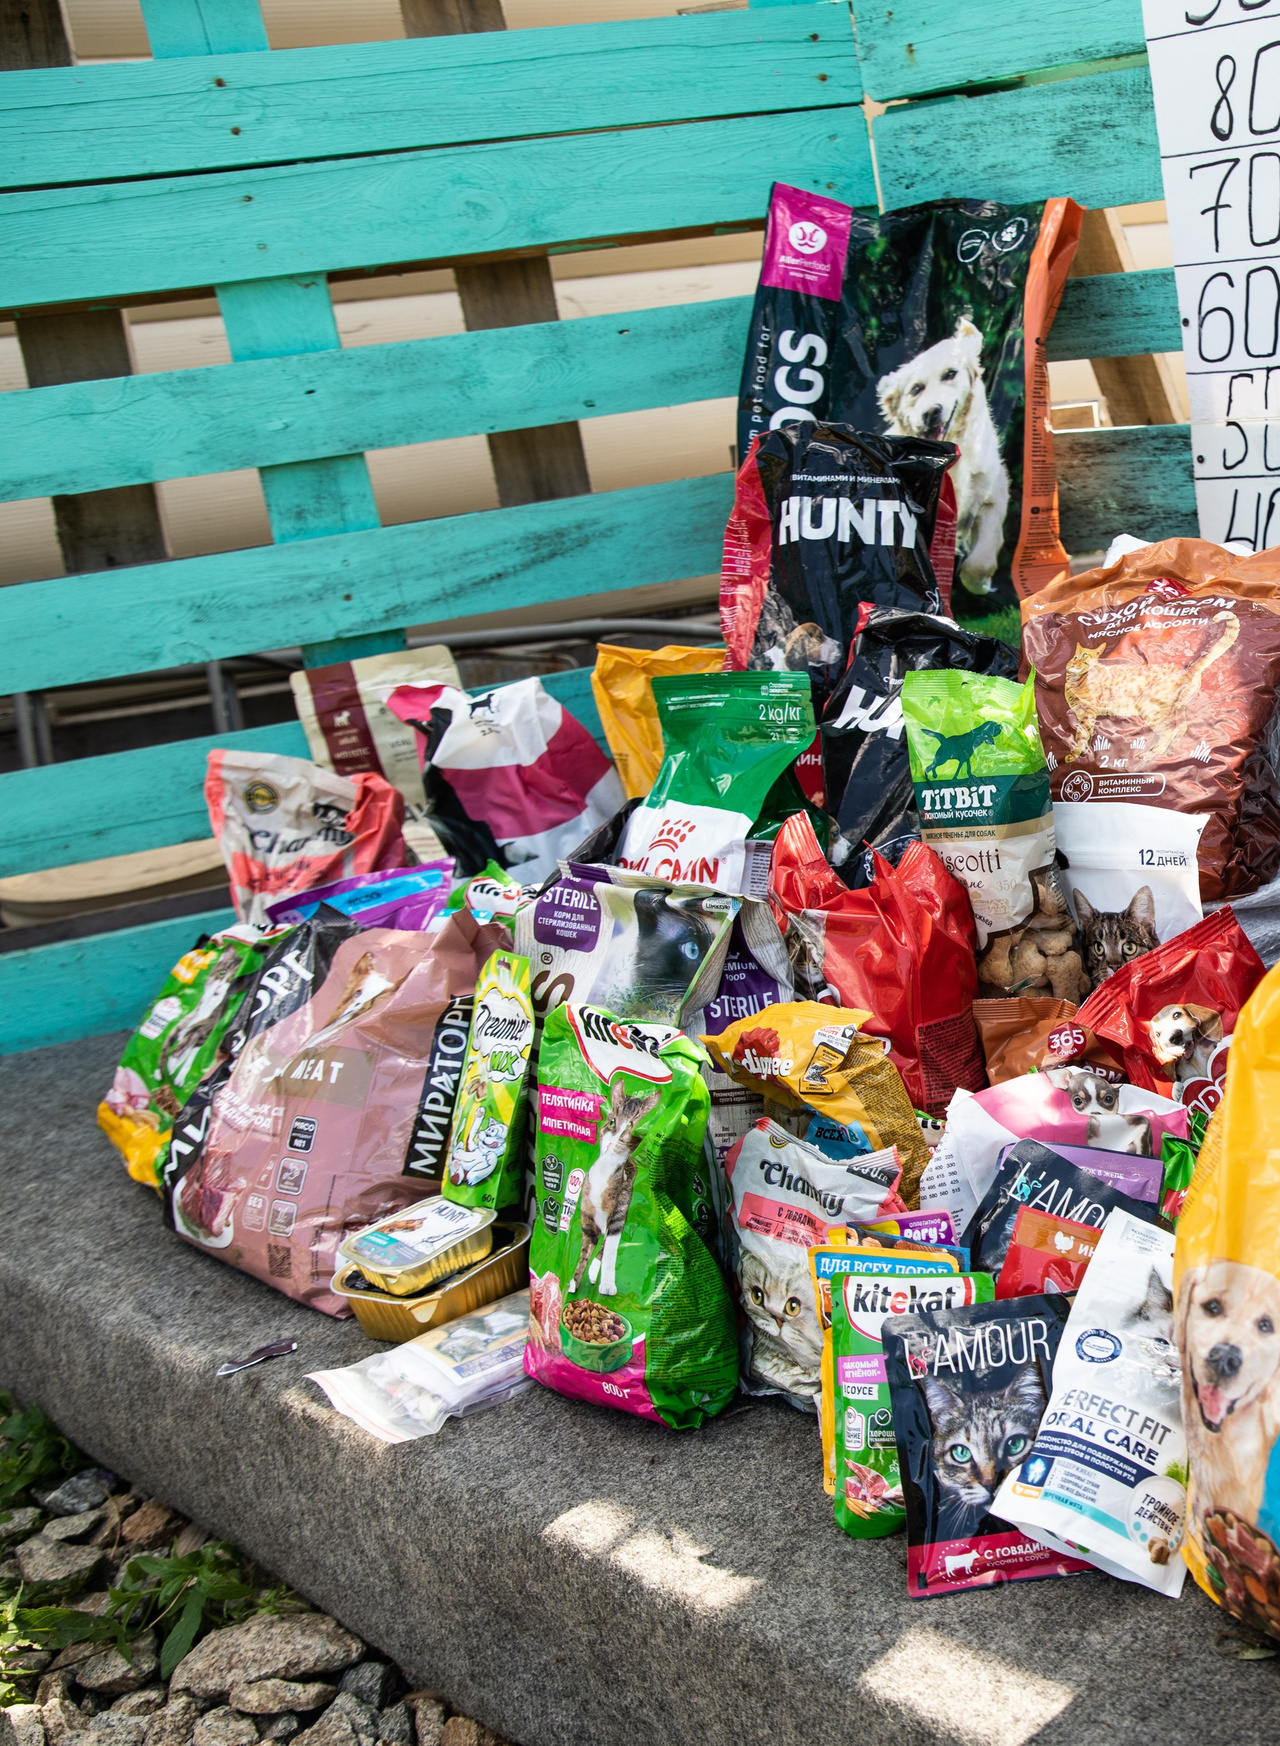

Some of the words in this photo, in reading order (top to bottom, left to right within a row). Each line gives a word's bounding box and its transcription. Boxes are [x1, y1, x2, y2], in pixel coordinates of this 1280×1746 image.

[763, 325, 772, 349] for
[754, 352, 767, 392] food
[751, 402, 764, 424] pet
[779, 496, 918, 549] HUNTY
[1077, 594, 1154, 627] СУХОЙ
[1139, 606, 1202, 618] КОШЕК
[1086, 624, 1143, 640] МЯСНОЕ
[1144, 617, 1209, 629] АССОРТИ
[759, 705, 767, 721] 2
[1100, 755, 1109, 768] 2
[1113, 758, 1129, 770] кг
[1097, 785, 1142, 795] КОМПЛЕКС
[1098, 776, 1155, 787] ВИТАМИННЫЙ
[924, 810, 955, 821] лакомый
[955, 808, 989, 821] кусочек
[964, 830, 976, 839] ДЛЯ
[976, 828, 996, 839] СОБАК
[935, 847, 1002, 875] iscotti
[1138, 848, 1156, 867] 12
[1156, 854, 1188, 868] ДНЕЙ
[543, 887, 598, 911] STERILE
[537, 917, 597, 933] СТЕРИЛИЗОВАННЫХ
[553, 909, 570, 919] КОРМ
[570, 912, 585, 922] ДЛЯ
[556, 929, 577, 939] КОШЕК
[1048, 1029, 1085, 1050] 365
[489, 1049, 520, 1077] MIX
[1059, 1047, 1079, 1058] дней
[290, 1059, 345, 1084] MEAT
[541, 1092, 595, 1113] ТЕЛЯТИНКА
[541, 1116, 592, 1137] АППЕТИТНАЯ
[814, 1125, 844, 1142] ВСЕХ
[431, 1204, 470, 1224] HUNTY
[820, 1257, 851, 1275] ДЛЯ
[853, 1261, 892, 1273] ВСЕХ
[853, 1283, 956, 1315] kitekat
[903, 1319, 1052, 1381] L'AMOUR
[601, 1380, 631, 1400] 800г
[1045, 1411, 1097, 1438] ORAL
[1103, 1428, 1159, 1467] CARE
[1138, 1415, 1172, 1446] FIT
[1063, 1447, 1085, 1460] ЗУБОВ
[1089, 1456, 1123, 1477] ПОЛОСТИ
[1122, 1471, 1135, 1483] РТА
[1071, 1441, 1087, 1451] ДЛЯ
[1086, 1446, 1138, 1475] ПОДДЕРЖАНИЯ
[1140, 1493, 1180, 1526] ТРОЙНОЕ
[1134, 1506, 1174, 1536] ДЕЙСТВИЕ
[984, 1549, 993, 1560] С
[985, 1557, 1018, 1568] кусочки
[1025, 1552, 1051, 1563] соусе
